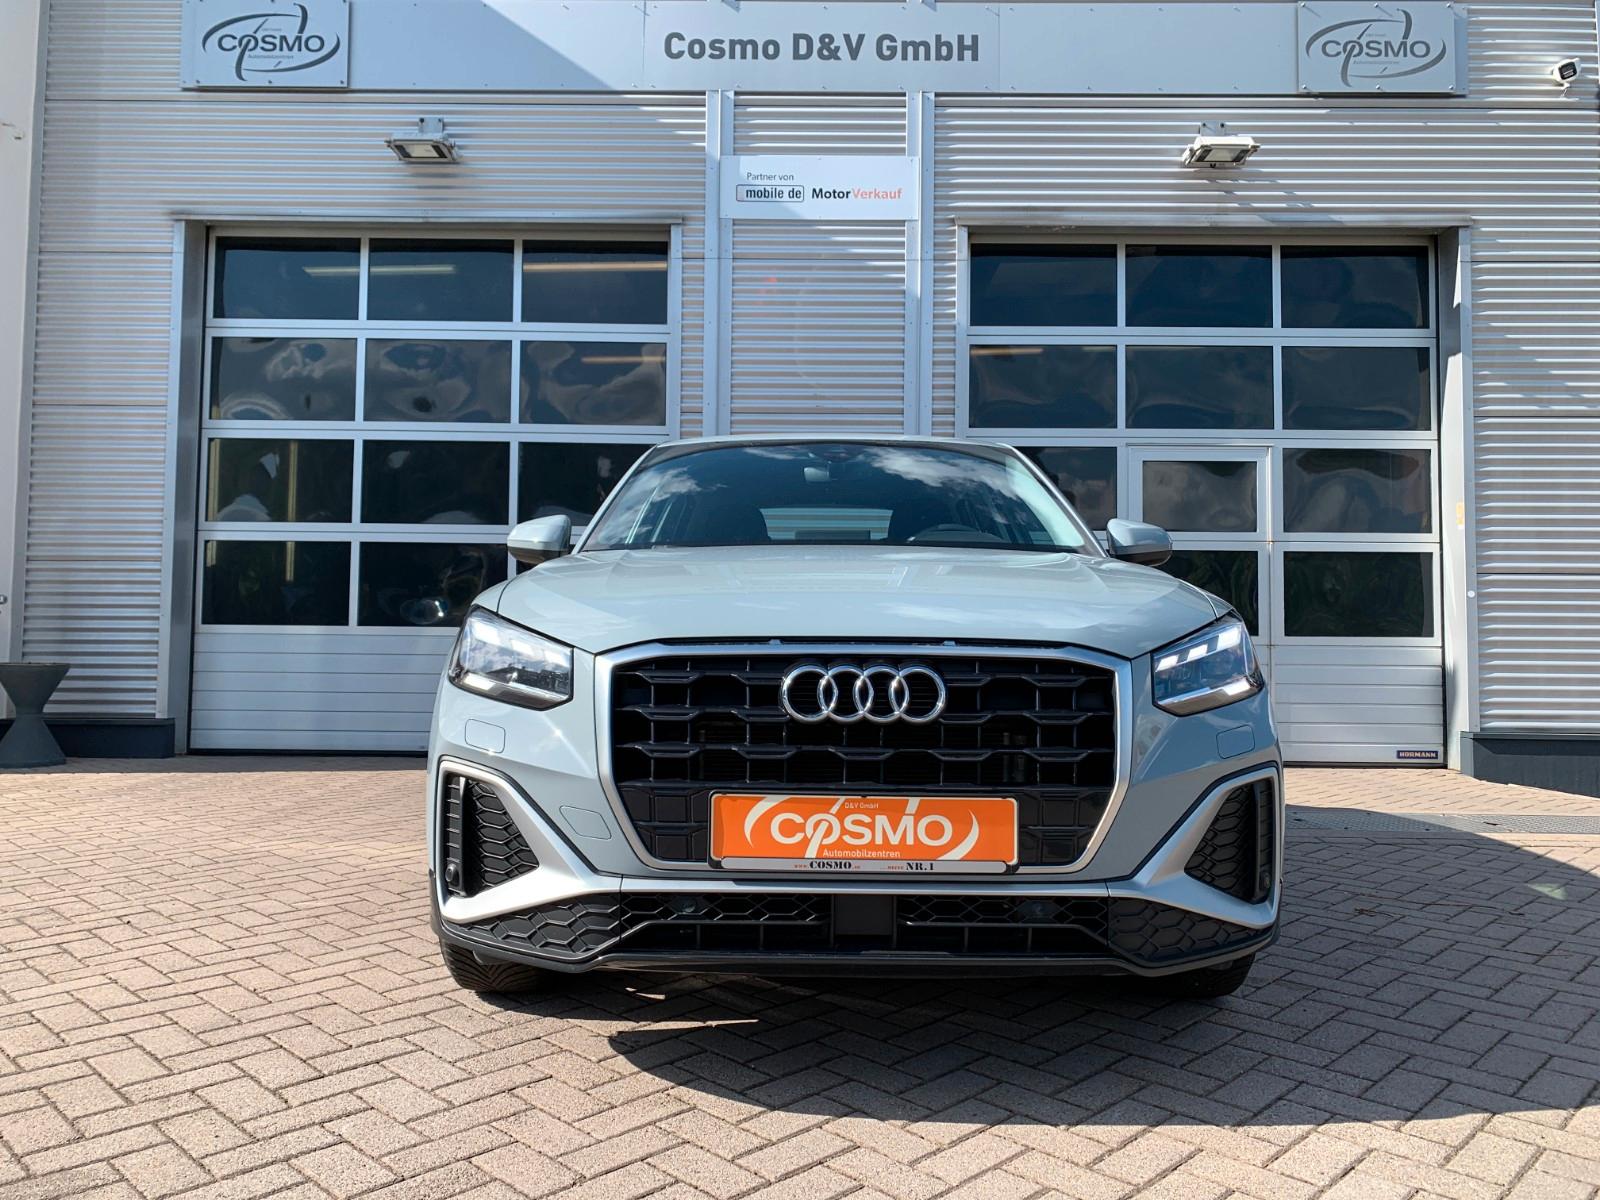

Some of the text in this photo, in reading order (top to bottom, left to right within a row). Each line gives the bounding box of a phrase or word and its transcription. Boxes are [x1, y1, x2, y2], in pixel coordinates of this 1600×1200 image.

[217, 33, 325, 52] COSMO
[664, 32, 979, 62] Cosmo D&V GmbH
[1321, 40, 1431, 58] COSMO
[746, 172, 777, 181] Partner
[770, 812, 953, 846] COSMO
[822, 848, 901, 859] Automobilzentren
